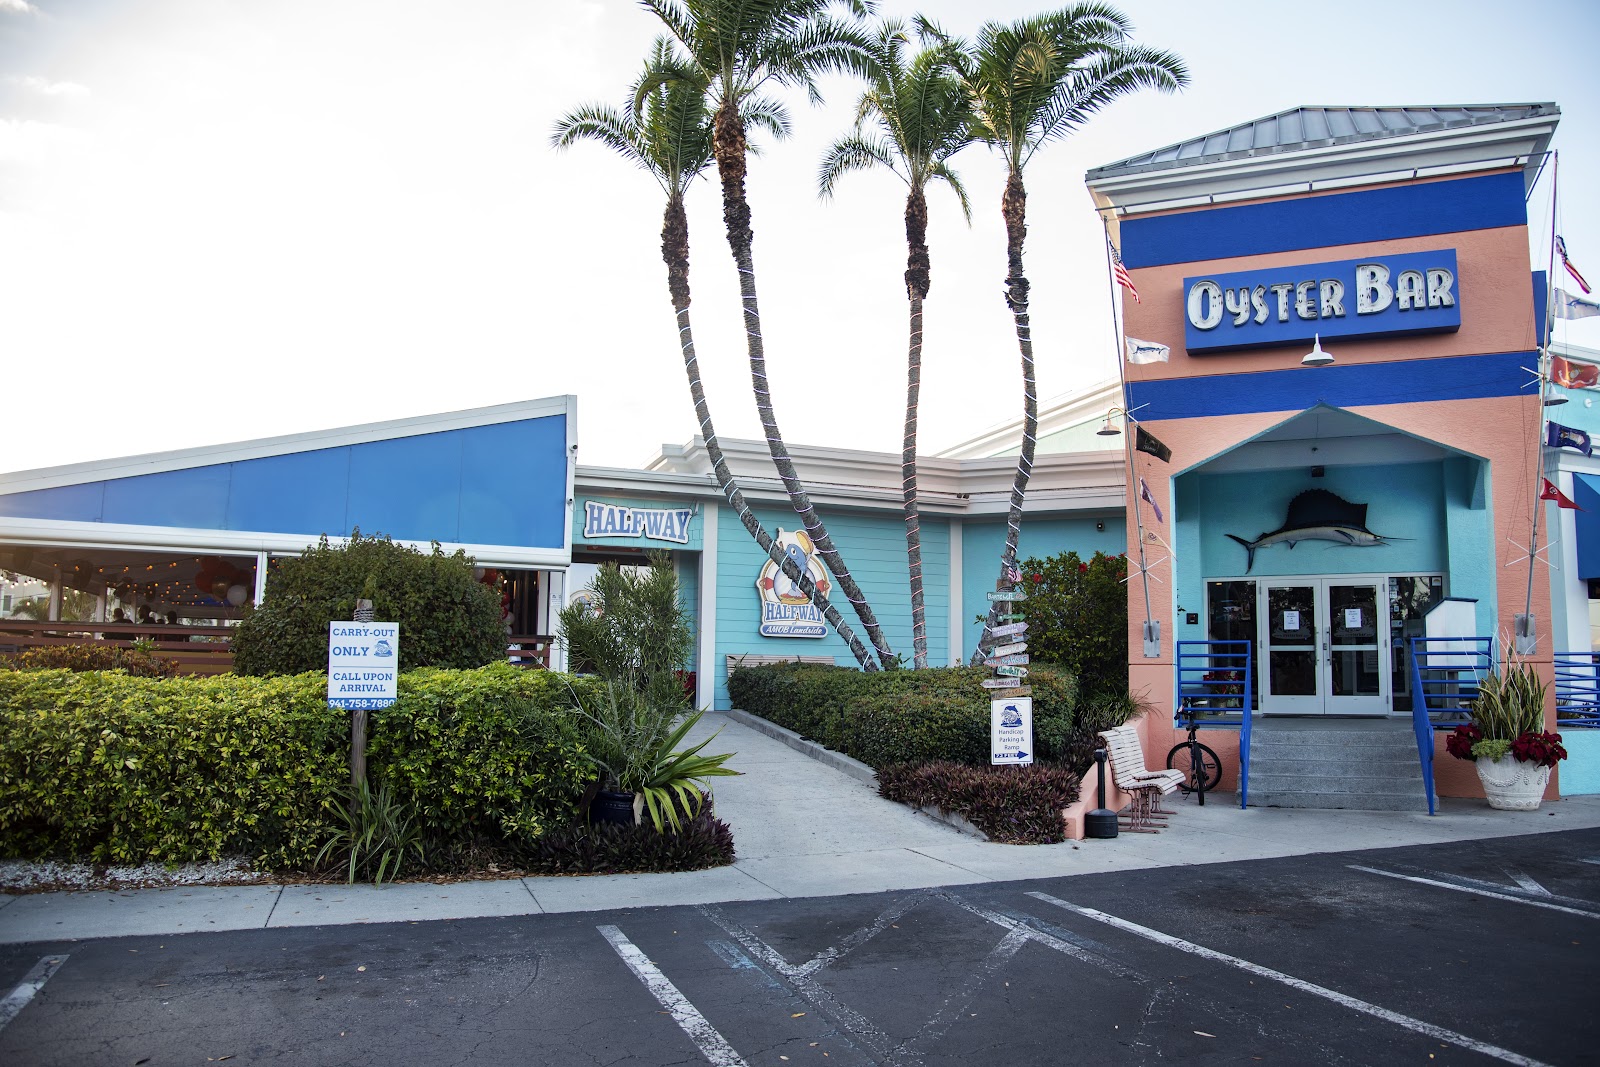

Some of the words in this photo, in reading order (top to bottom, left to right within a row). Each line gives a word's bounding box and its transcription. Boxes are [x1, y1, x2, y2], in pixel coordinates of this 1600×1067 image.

[1187, 279, 1346, 330] OYSTER
[1355, 262, 1455, 316] BAR
[587, 503, 690, 541] HALFWAY
[765, 602, 824, 622] HALFWAY
[332, 628, 395, 637] CARRY-OUT
[766, 624, 789, 634] AMOB
[790, 625, 822, 635] Landside
[332, 646, 370, 657] ONLY
[333, 672, 361, 681] CALL
[363, 673, 393, 681] UPON
[339, 684, 386, 692] ARRIVAL
[329, 699, 395, 708] 941-758-7880
